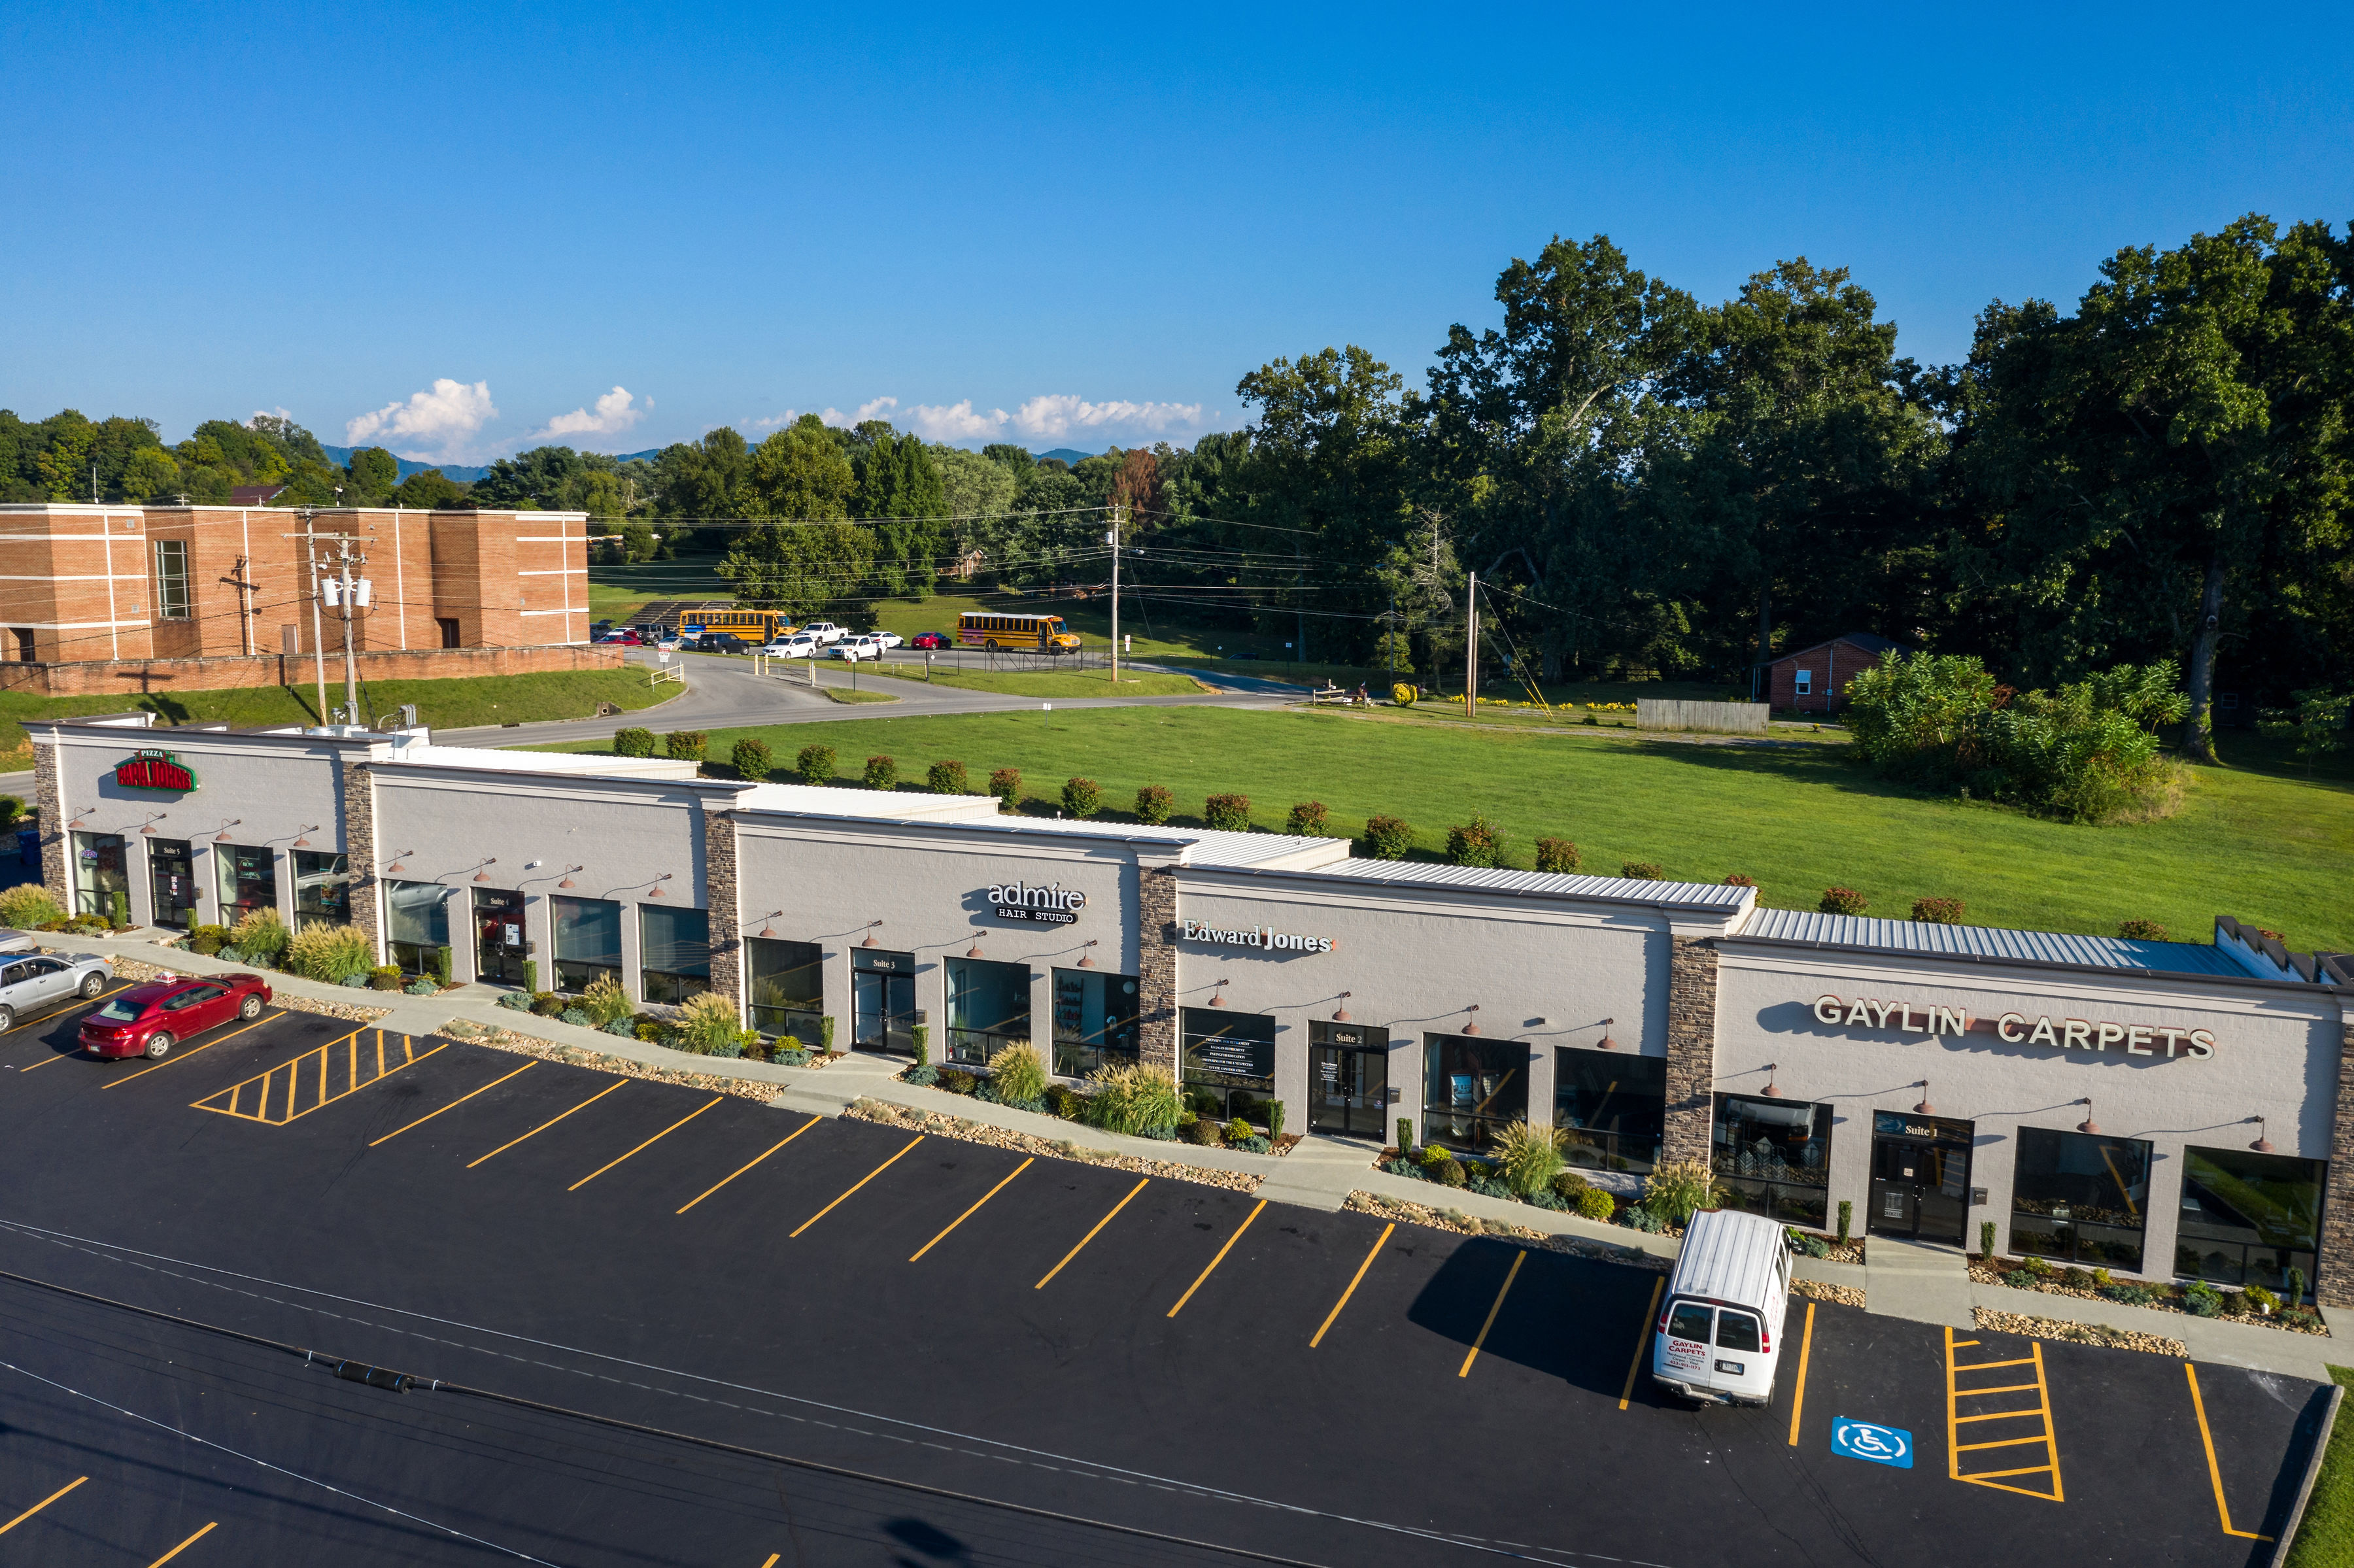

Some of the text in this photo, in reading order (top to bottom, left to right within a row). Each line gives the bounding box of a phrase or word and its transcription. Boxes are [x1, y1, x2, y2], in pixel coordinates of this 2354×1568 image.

[118, 762, 150, 787] PAPA
[490, 897, 505, 906] Suite
[998, 908, 1073, 923] HAIR STUDIO
[1183, 919, 1333, 953] Edward Jones
[873, 959, 890, 968] Suite
[1814, 995, 2216, 1061] GAYLIN CARPETS
[1336, 1033, 1356, 1044] Suite
[1905, 1125, 1938, 1137] Suite 1
[1673, 1340, 1703, 1350] GAYLIN
[1669, 1346, 1705, 1356] CARPETS
